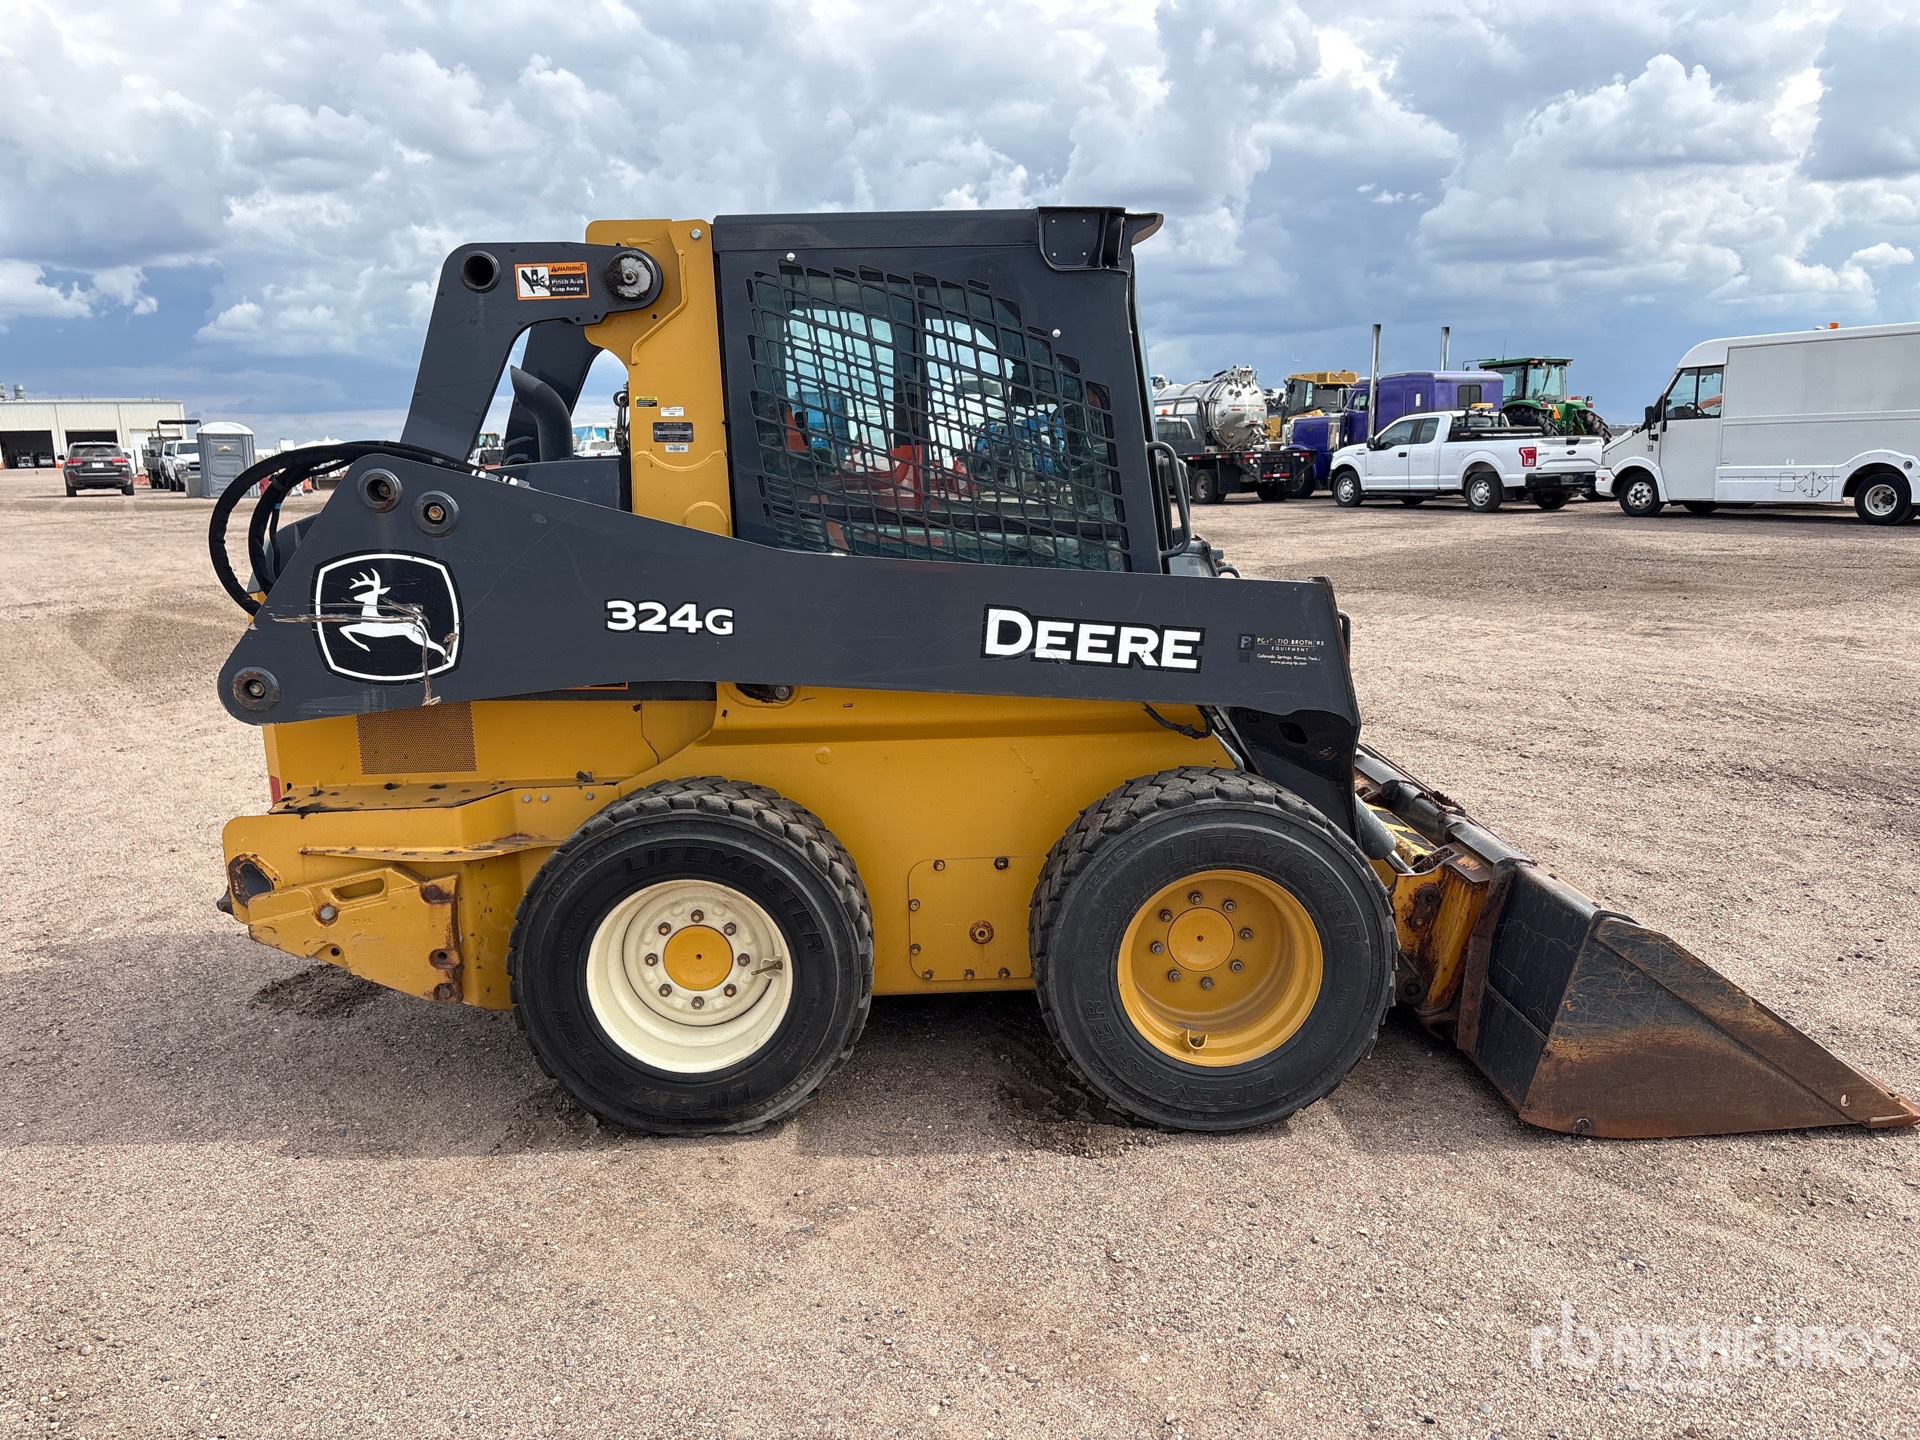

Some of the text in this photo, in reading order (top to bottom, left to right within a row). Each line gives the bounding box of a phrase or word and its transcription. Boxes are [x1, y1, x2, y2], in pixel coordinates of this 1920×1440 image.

[605, 599, 734, 636] 324G
[984, 607, 1202, 670] DEERE
[545, 842, 608, 905] 12-16.5
[623, 845, 824, 953] LIFEMASTER
[1083, 832, 1147, 894] 12-16.5
[1163, 834, 1359, 945] LIFEMASTER
[549, 1007, 754, 1111] LIFEMASTER
[1083, 999, 1280, 1104] LIFEMASTER
